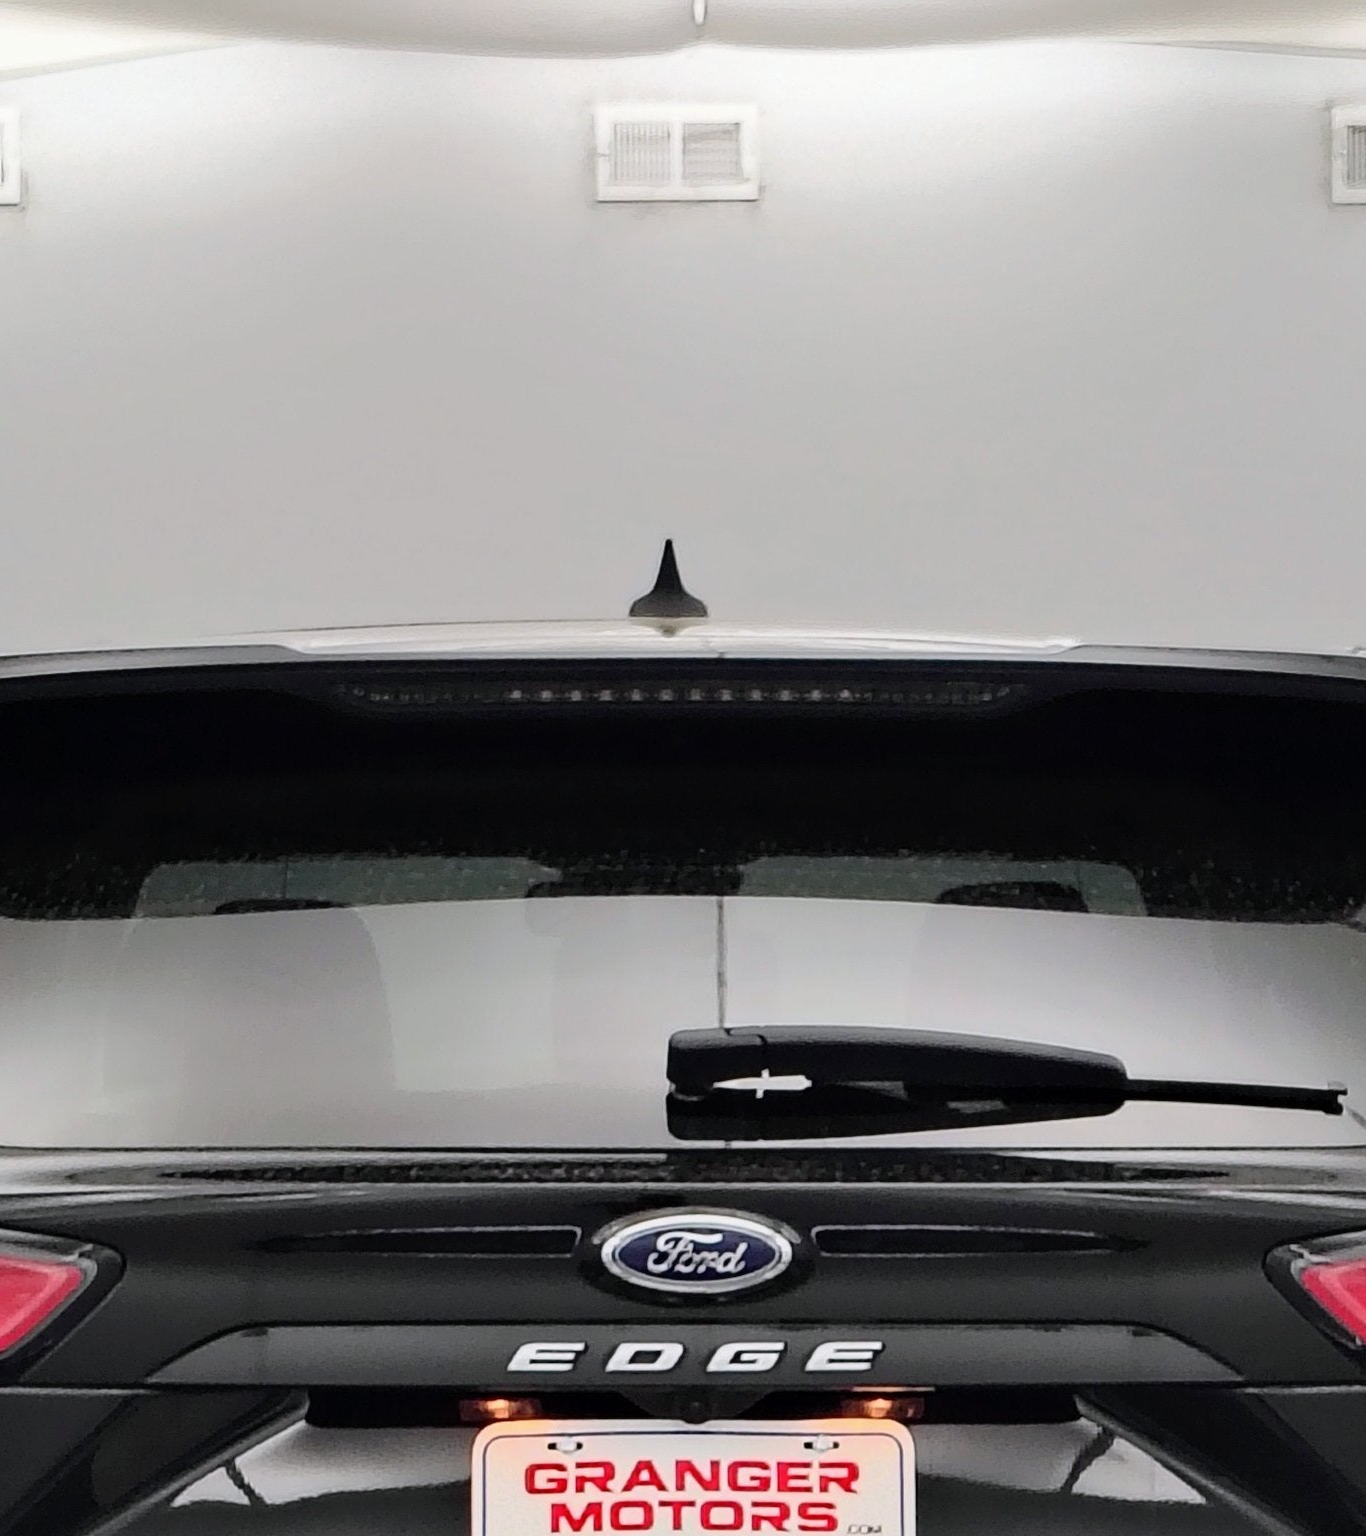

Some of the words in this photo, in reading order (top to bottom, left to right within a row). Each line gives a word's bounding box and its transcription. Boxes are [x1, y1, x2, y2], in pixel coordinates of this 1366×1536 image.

[646, 1231, 746, 1275] Ford
[506, 1341, 883, 1373] EDGE
[524, 1460, 860, 1494] GRANGER
[550, 1501, 839, 1533] MOTORS
